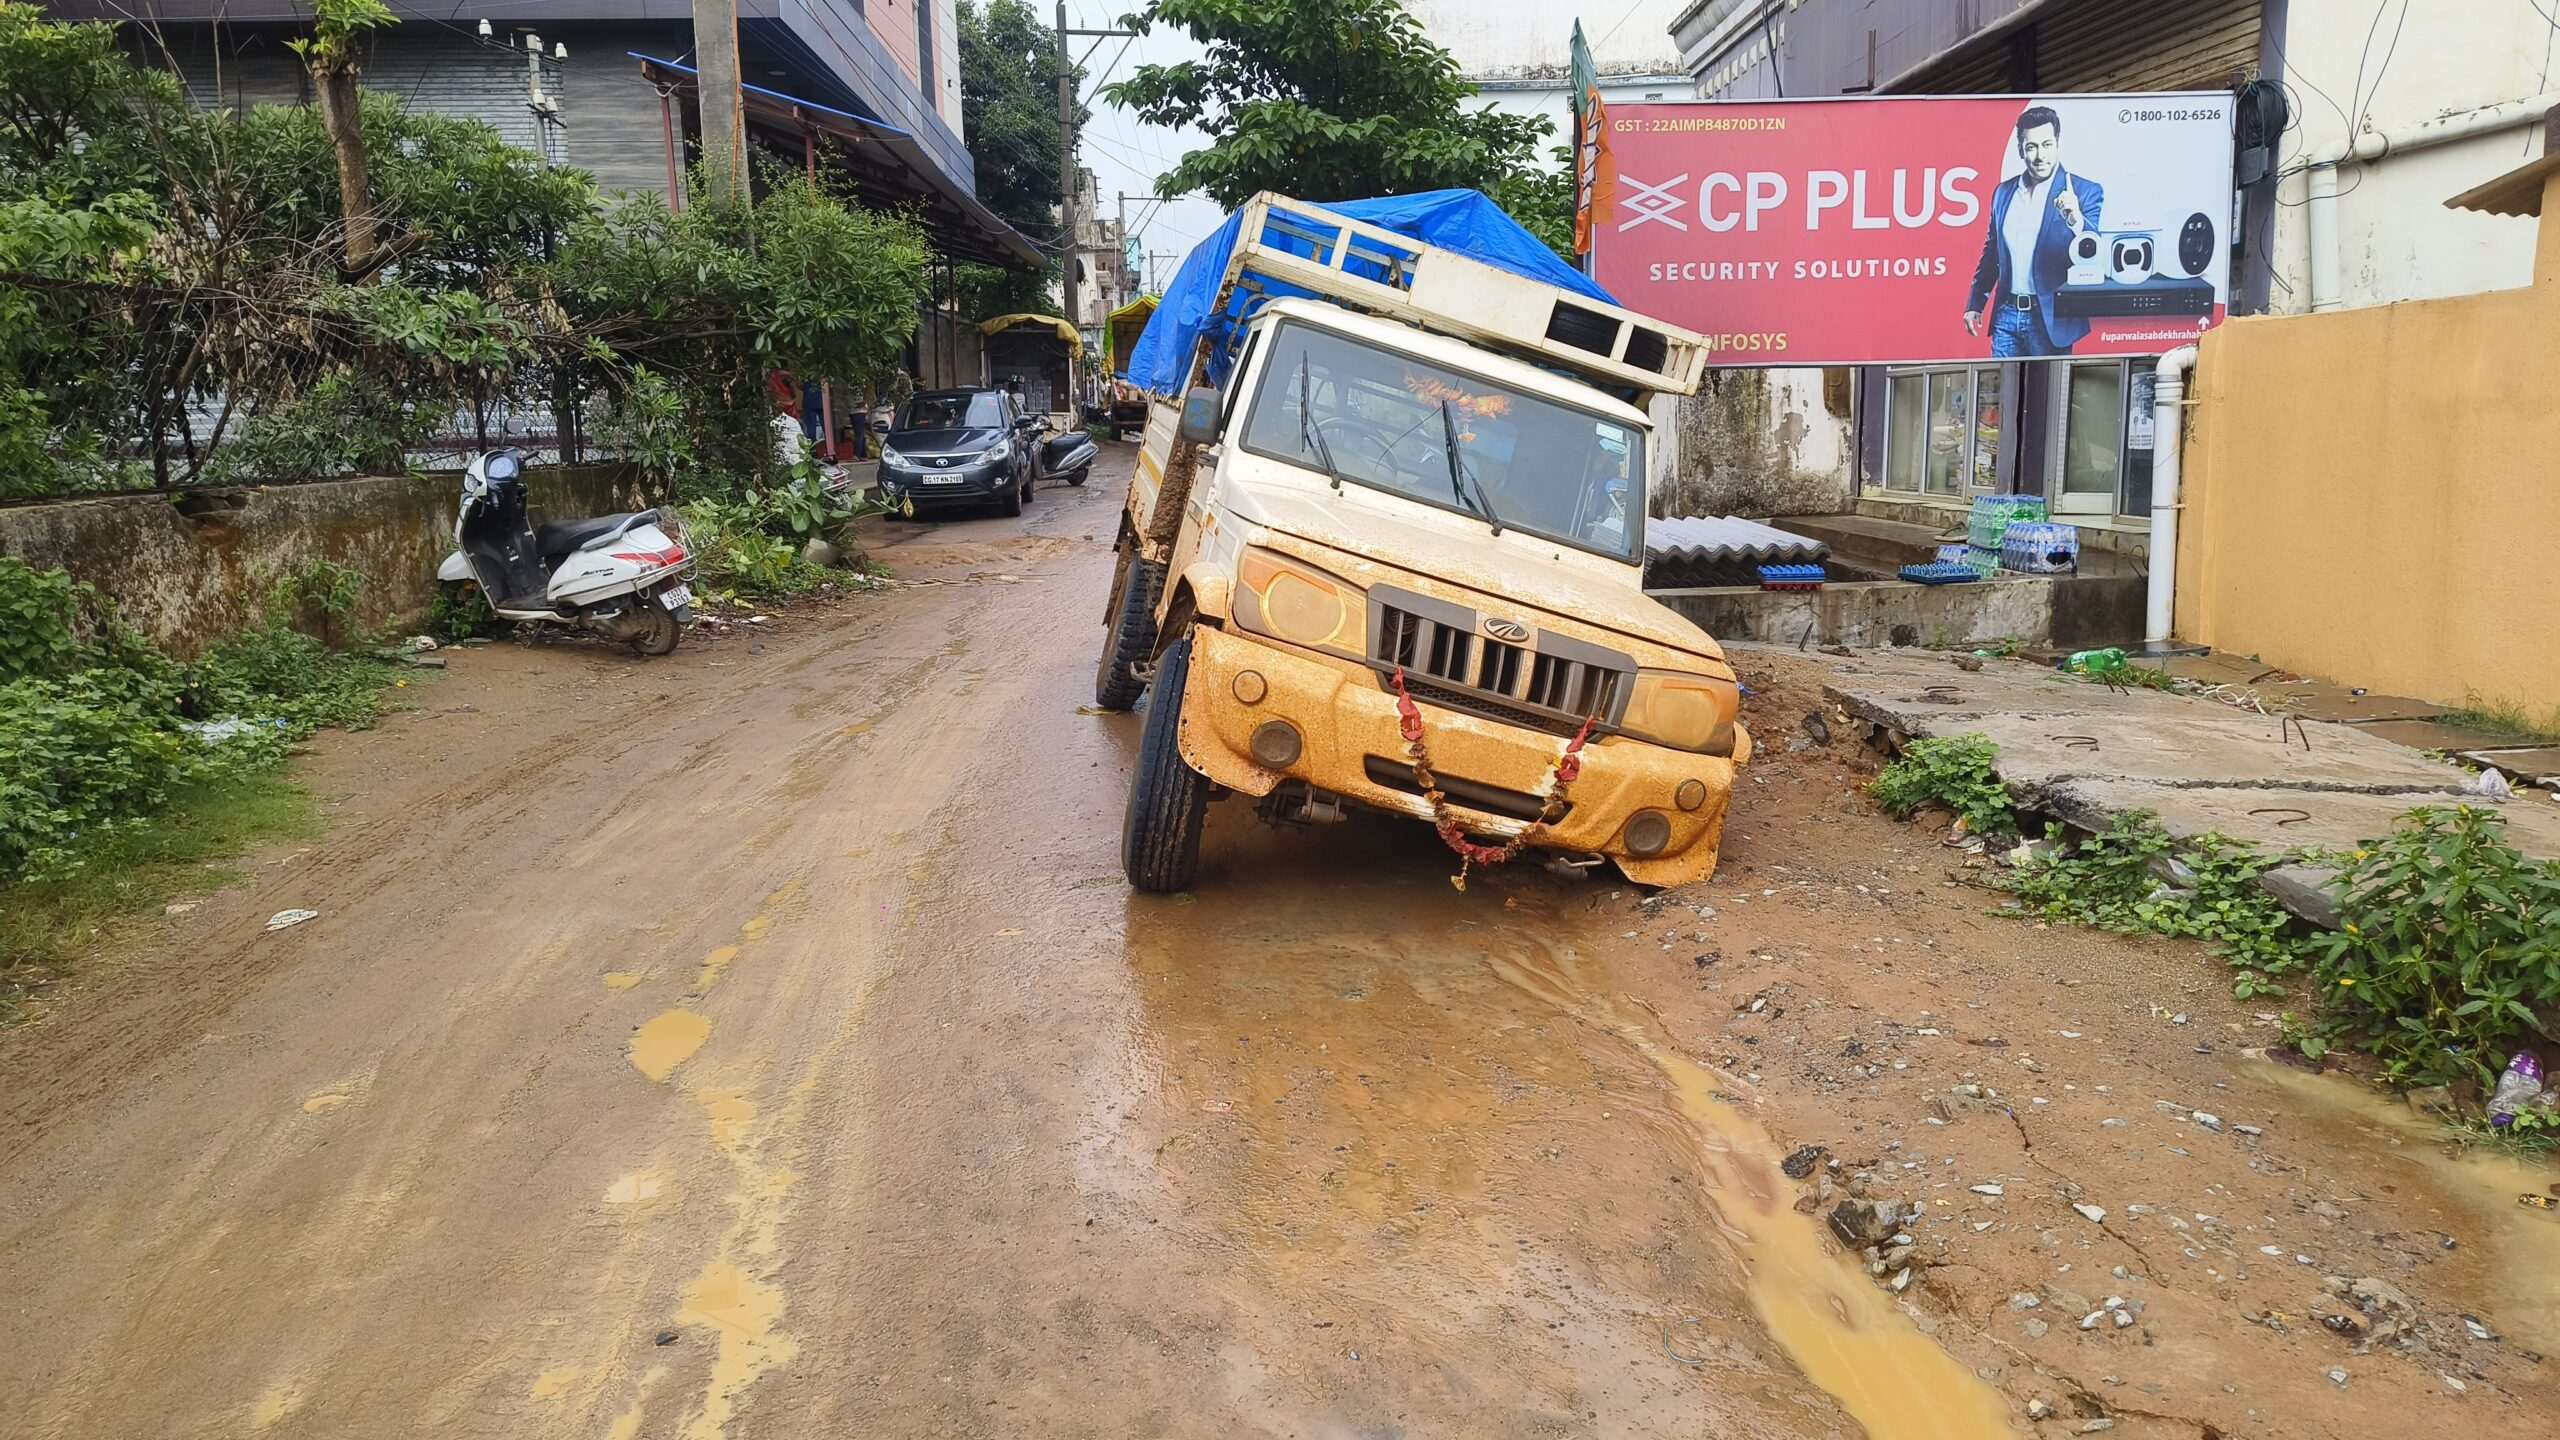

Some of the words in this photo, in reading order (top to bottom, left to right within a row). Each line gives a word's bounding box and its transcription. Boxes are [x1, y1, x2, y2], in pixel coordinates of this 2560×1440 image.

[2133, 109, 2221, 121] 1800-102-6526
[1614, 119, 1642, 132] GST
[1652, 118, 1786, 132] 22AIMPB4870D1ZN
[1699, 171, 1788, 232] CP
[1806, 167, 1980, 230] PLUS
[1650, 261, 1780, 281] SECURITY
[1794, 257, 1948, 280] SOLUTIONS
